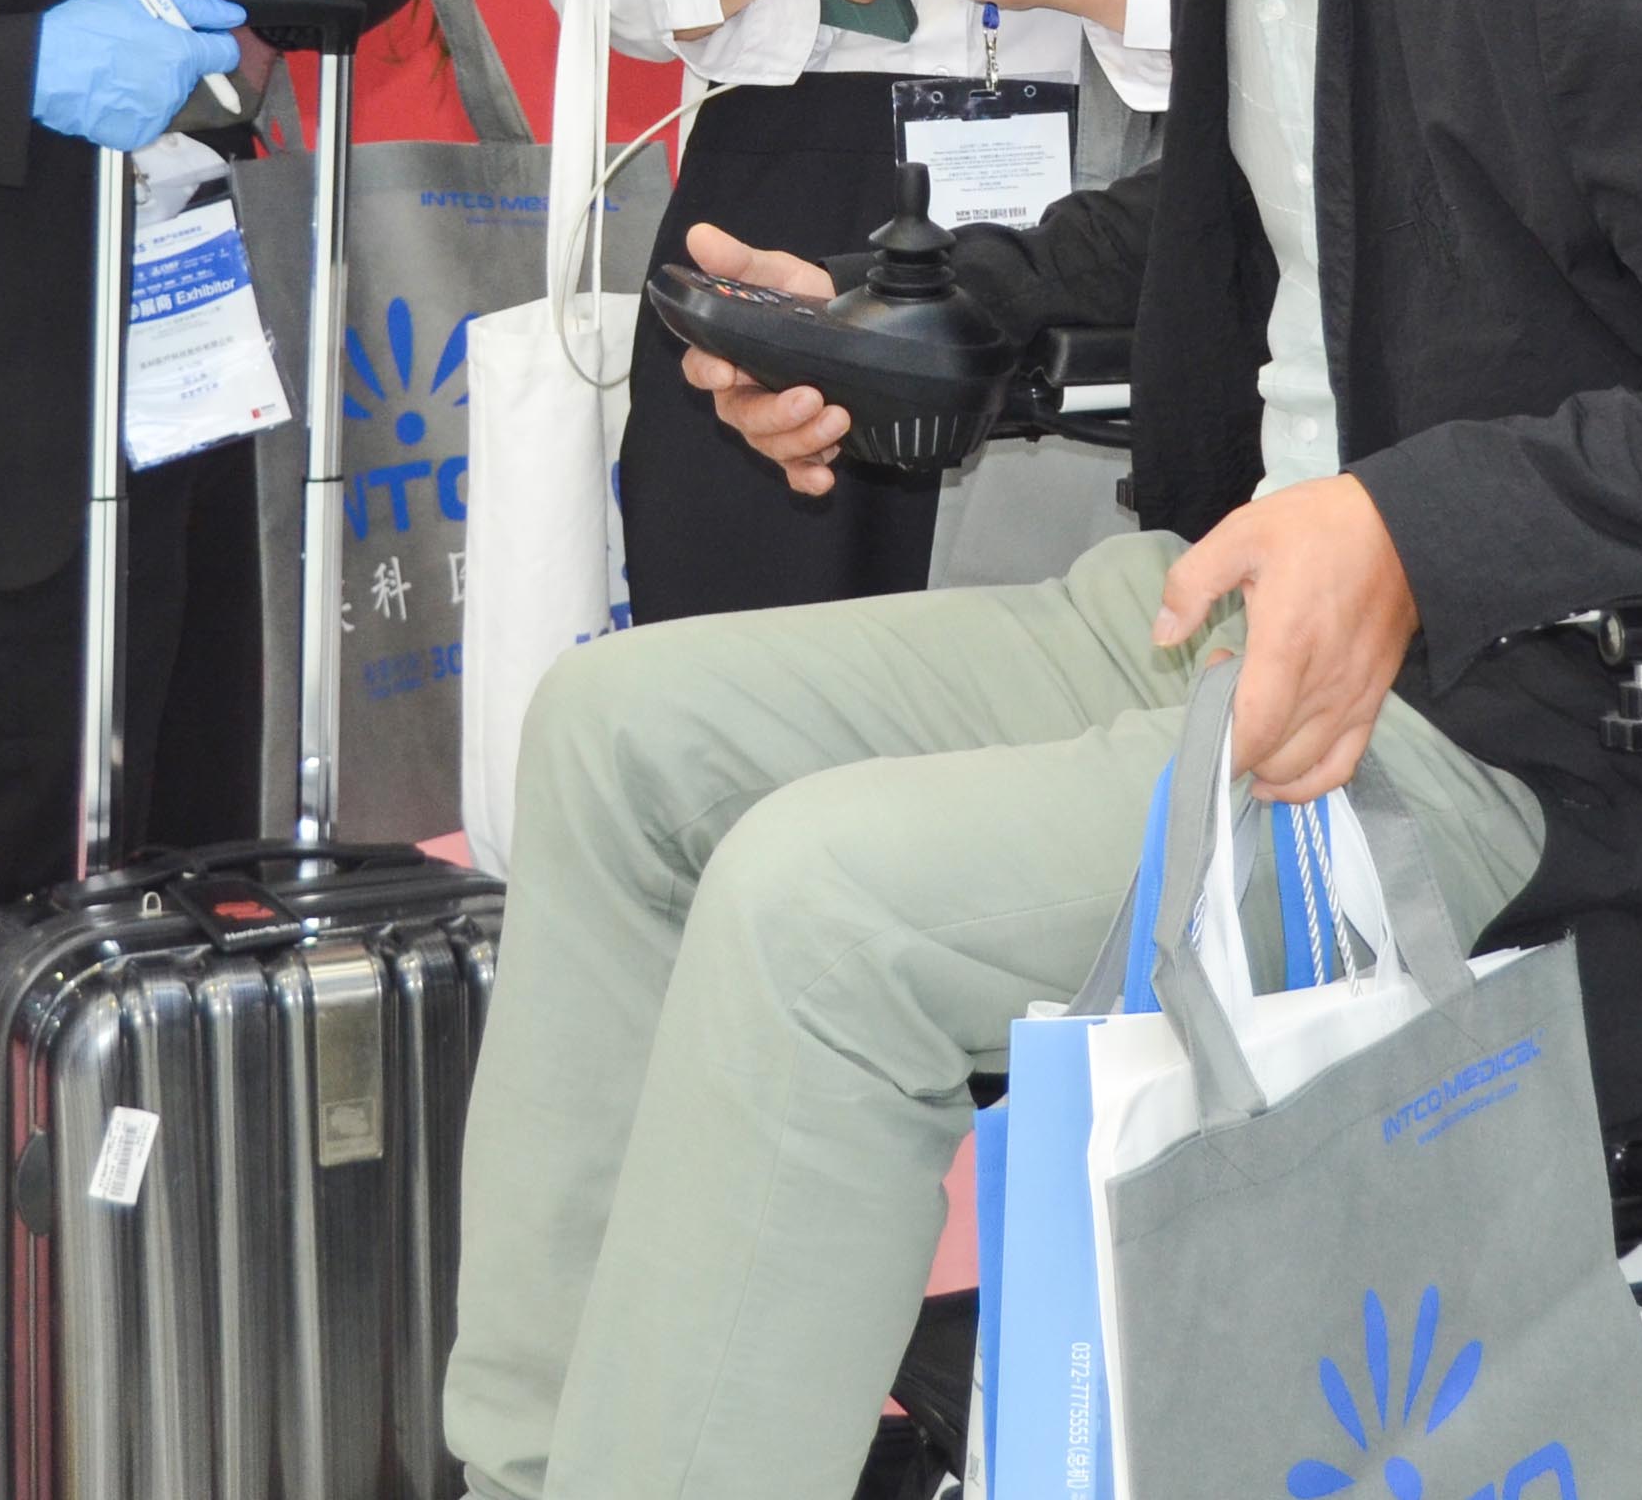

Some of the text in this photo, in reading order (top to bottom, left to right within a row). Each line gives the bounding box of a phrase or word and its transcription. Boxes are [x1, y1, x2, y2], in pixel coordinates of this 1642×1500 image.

[176, 278, 236, 306] Exhibitor
[343, 455, 468, 542] NTC
[1382, 1086, 1442, 1145] INTCO
